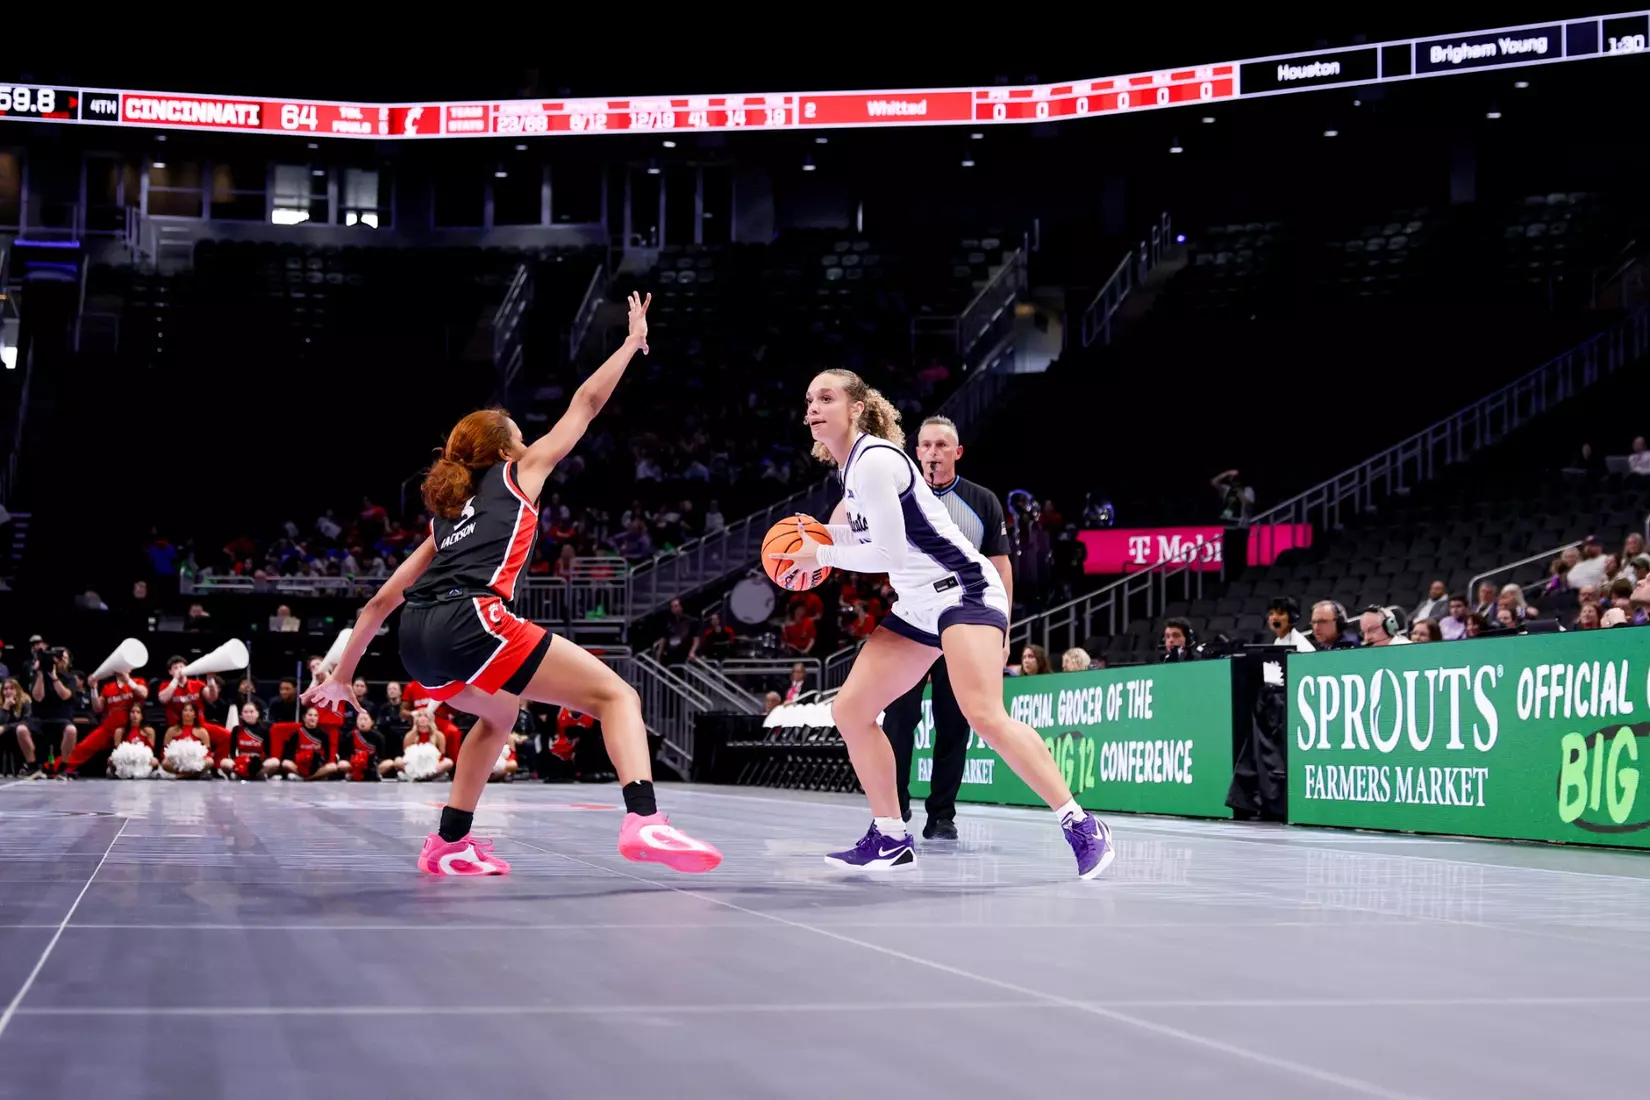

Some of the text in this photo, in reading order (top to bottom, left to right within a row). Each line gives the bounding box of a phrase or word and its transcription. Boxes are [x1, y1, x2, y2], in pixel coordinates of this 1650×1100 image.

[1430, 37, 1548, 64] Brigham Young
[1277, 61, 1340, 82] Houston
[1117, 92, 1130, 110] 0
[1156, 87, 1169, 105] 0
[1200, 82, 1213, 100] 0
[90, 99, 117, 114] 4TH
[125, 97, 260, 126] CINCINNATI
[281, 104, 318, 131] 64
[725, 109, 747, 126] 14
[867, 99, 927, 117] Whitted
[993, 103, 1006, 120] 0
[1036, 101, 1049, 119] 0
[1076, 96, 1089, 114] 0
[688, 110, 710, 127] 41
[440, 522, 477, 550] JACKSON
[1128, 533, 1222, 564] T Mobi
[1517, 659, 1634, 720] OFFICIAL
[1011, 693, 1054, 728] OFFICIAL
[1058, 686, 1103, 726] GROCER
[1107, 683, 1124, 720] OF
[1127, 679, 1154, 719] THE
[961, 759, 995, 784] ARKET
[1079, 737, 1095, 793] 12
[1101, 739, 1193, 784] CONFERENCE
[1305, 764, 1489, 807] FARMERS MARKET
[1558, 726, 1640, 824] BIG
